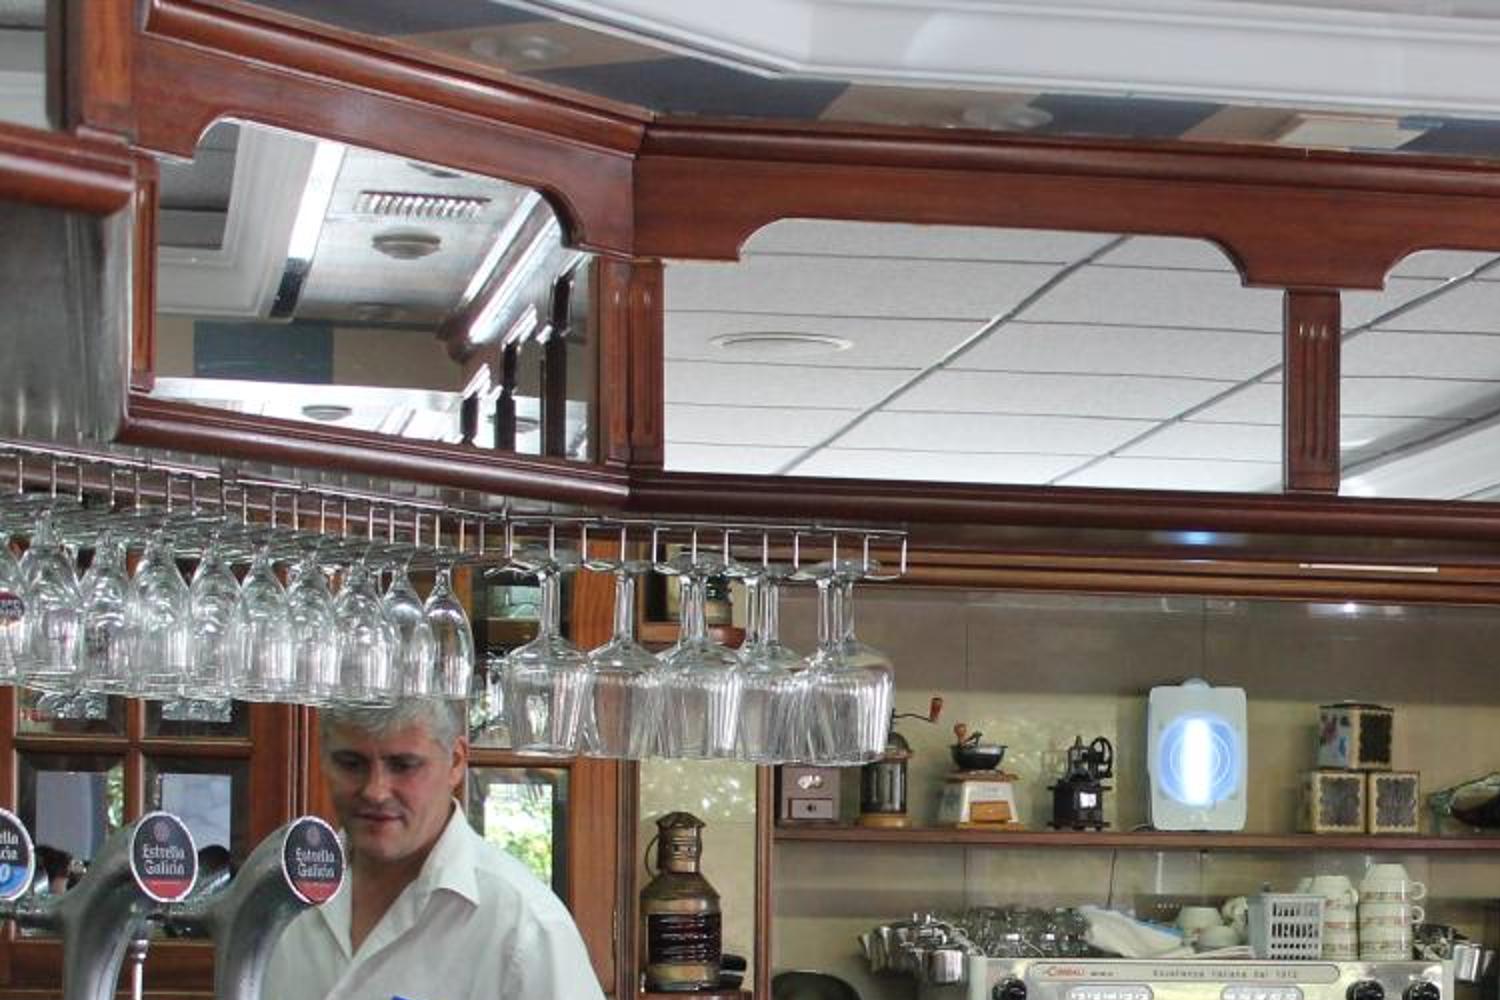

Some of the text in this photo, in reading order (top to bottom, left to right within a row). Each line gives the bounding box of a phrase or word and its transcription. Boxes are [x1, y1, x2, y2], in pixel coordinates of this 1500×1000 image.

[142, 843, 185, 859] Estrella
[295, 848, 335, 864] Estrella
[143, 860, 185, 876] Galicia
